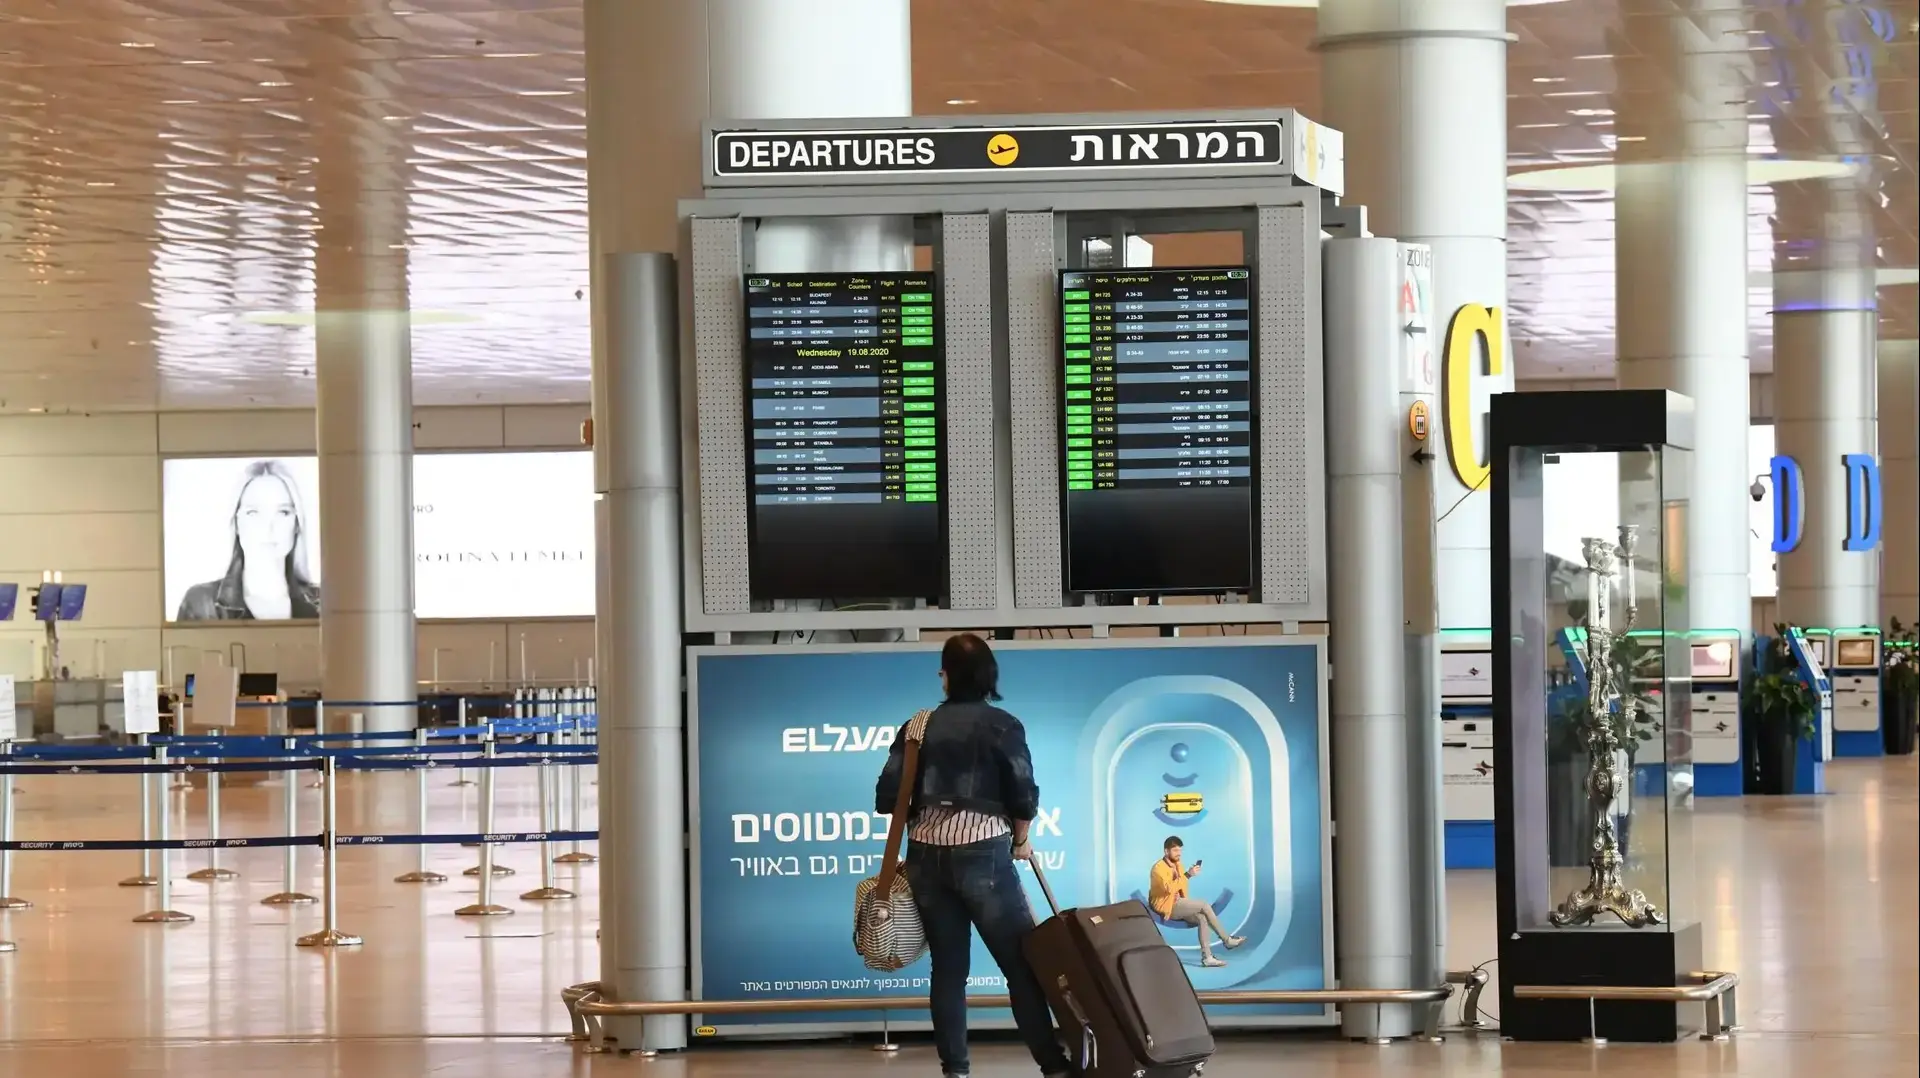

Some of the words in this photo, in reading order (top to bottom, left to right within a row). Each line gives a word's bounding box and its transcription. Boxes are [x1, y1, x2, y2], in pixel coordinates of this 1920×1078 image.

[730, 138, 935, 167] DEPARTURES
[1070, 131, 1265, 161] המראות
[797, 349, 841, 357] Wednesday
[1445, 303, 1502, 490] C
[1770, 456, 1804, 553] D
[1842, 454, 1882, 551] D
[184, 839, 217, 847] SECURITY
[730, 856, 801, 876] באוויר
[809, 855, 838, 875] גם
[740, 981, 771, 991] באתר
[774, 980, 828, 991] המפורטים
[831, 977, 870, 990] לתנאים
